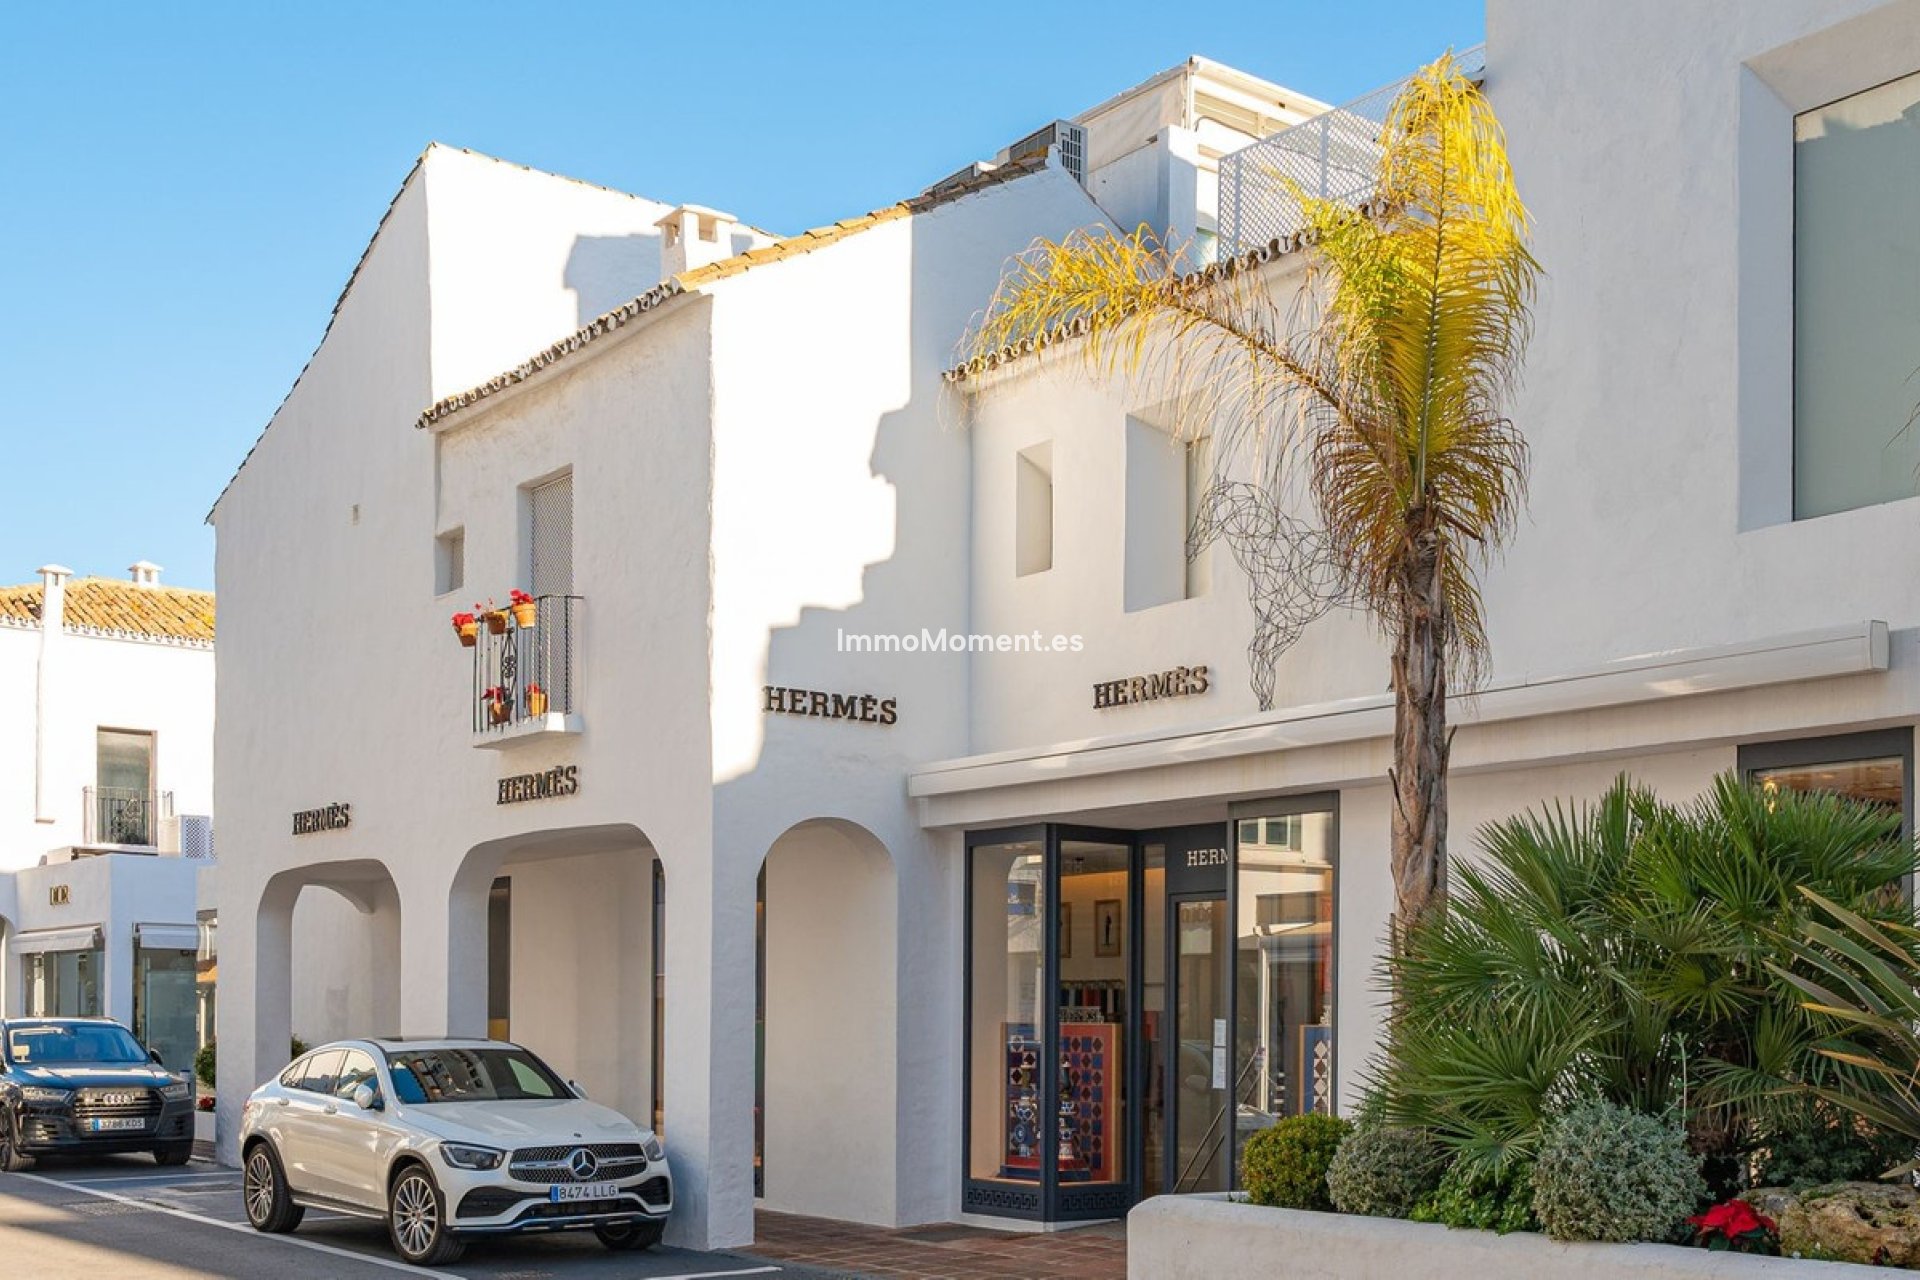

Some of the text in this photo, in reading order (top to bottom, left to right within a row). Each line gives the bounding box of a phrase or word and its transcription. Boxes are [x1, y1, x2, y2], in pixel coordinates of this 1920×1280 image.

[763, 685, 897, 725] HERMÈS
[1093, 665, 1208, 709] HERMÈS
[560, 1185, 616, 1199] 8474 LLG
